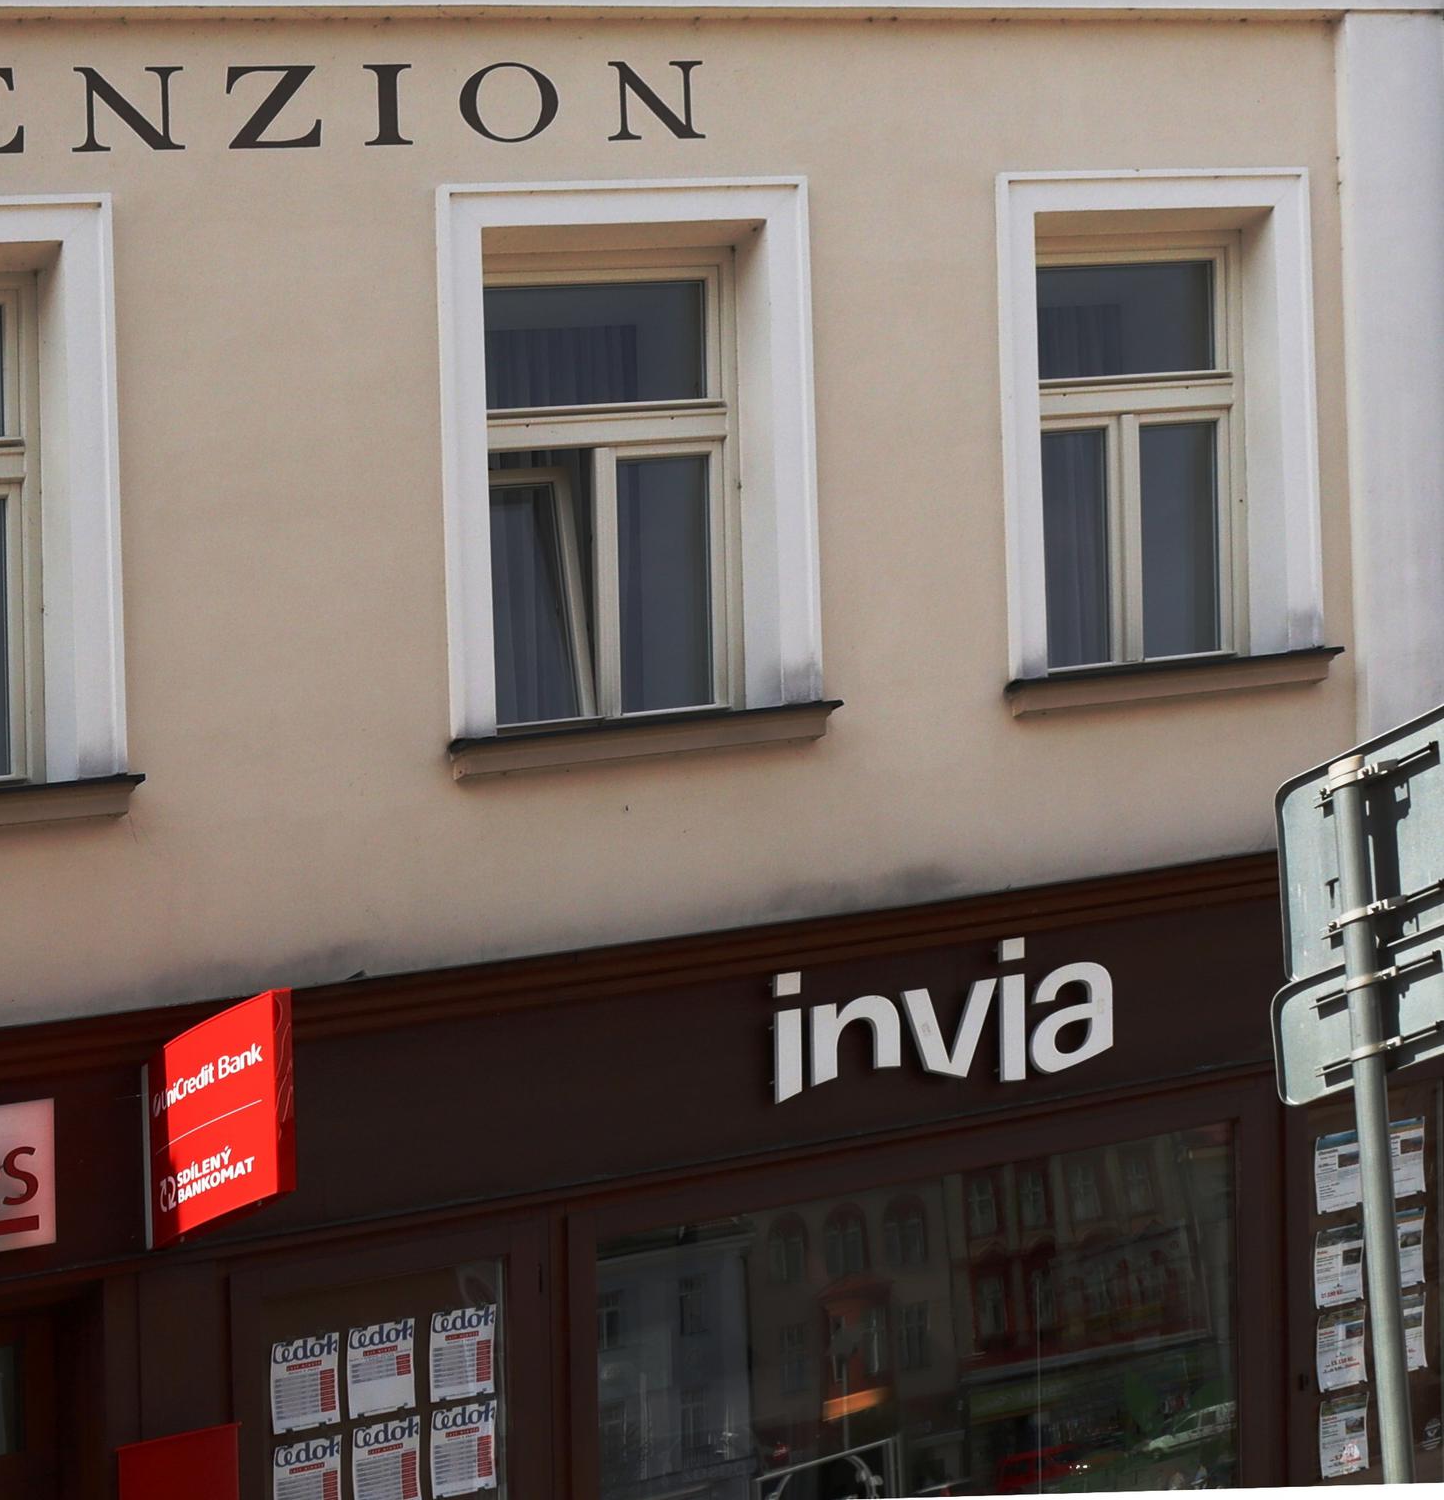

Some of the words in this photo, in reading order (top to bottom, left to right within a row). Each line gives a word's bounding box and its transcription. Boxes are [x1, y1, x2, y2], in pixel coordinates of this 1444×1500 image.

[772, 936, 1114, 1105] invia
[161, 1062, 215, 1111] UniCredit
[218, 1043, 263, 1080] Bank
[176, 1145, 232, 1187] SDÍLENÝ
[177, 1156, 255, 1204] BANKOMAT
